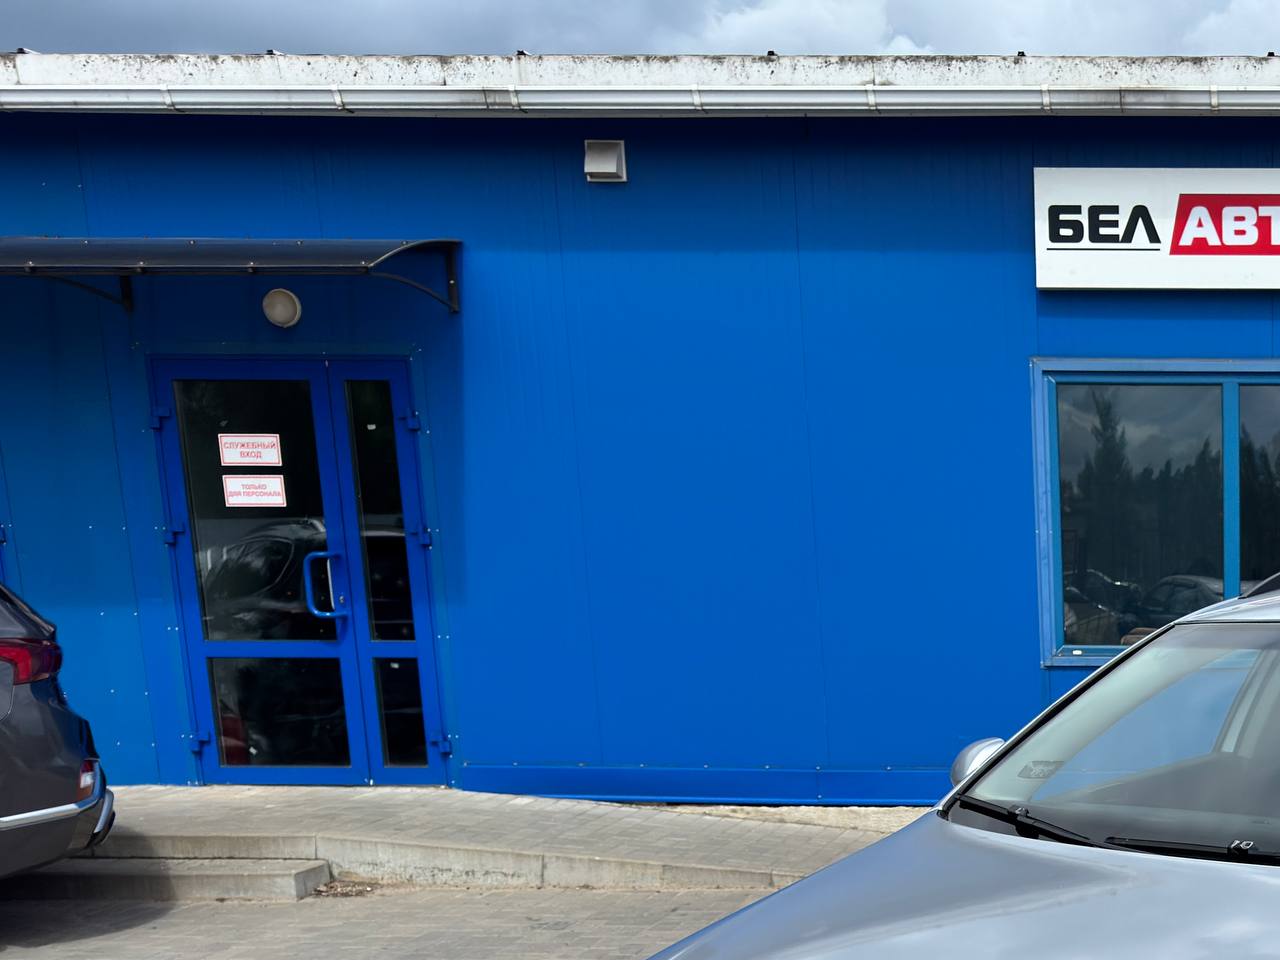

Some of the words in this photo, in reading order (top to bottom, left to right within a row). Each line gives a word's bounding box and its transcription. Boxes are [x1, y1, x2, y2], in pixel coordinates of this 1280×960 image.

[1047, 205, 1161, 244] БЕЛ
[224, 441, 277, 449] СЛУЖЕБНЫЙ
[240, 450, 262, 459] ВХОД
